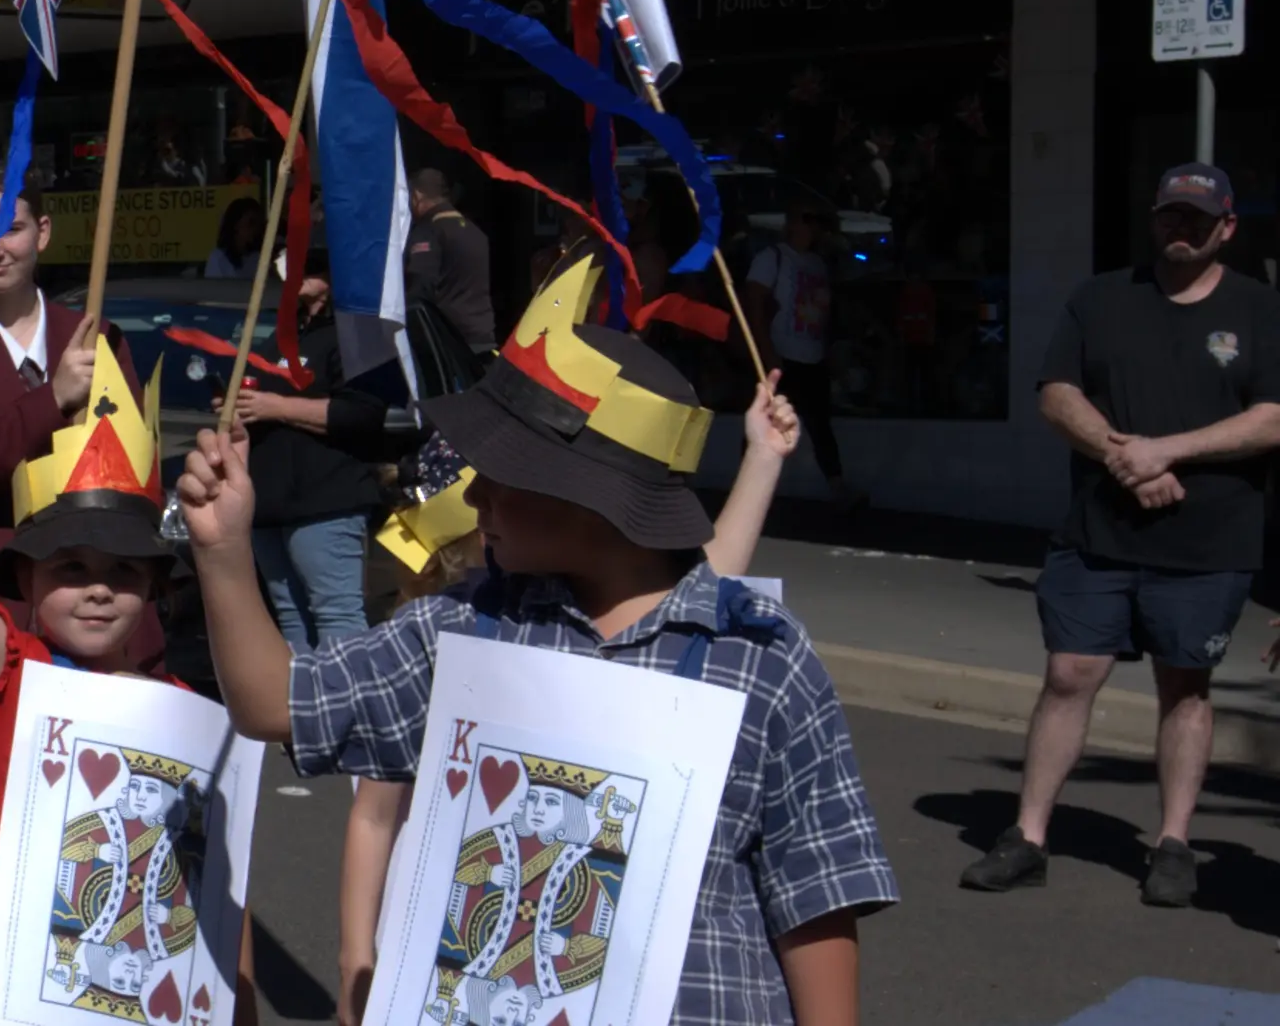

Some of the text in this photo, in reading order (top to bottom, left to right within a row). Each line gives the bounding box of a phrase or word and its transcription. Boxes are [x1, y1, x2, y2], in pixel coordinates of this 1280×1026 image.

[158, 188, 217, 211] STORE
[133, 214, 162, 239] CO
[149, 241, 182, 259] GIFT
[43, 716, 74, 756] K
[449, 718, 478, 764] K
